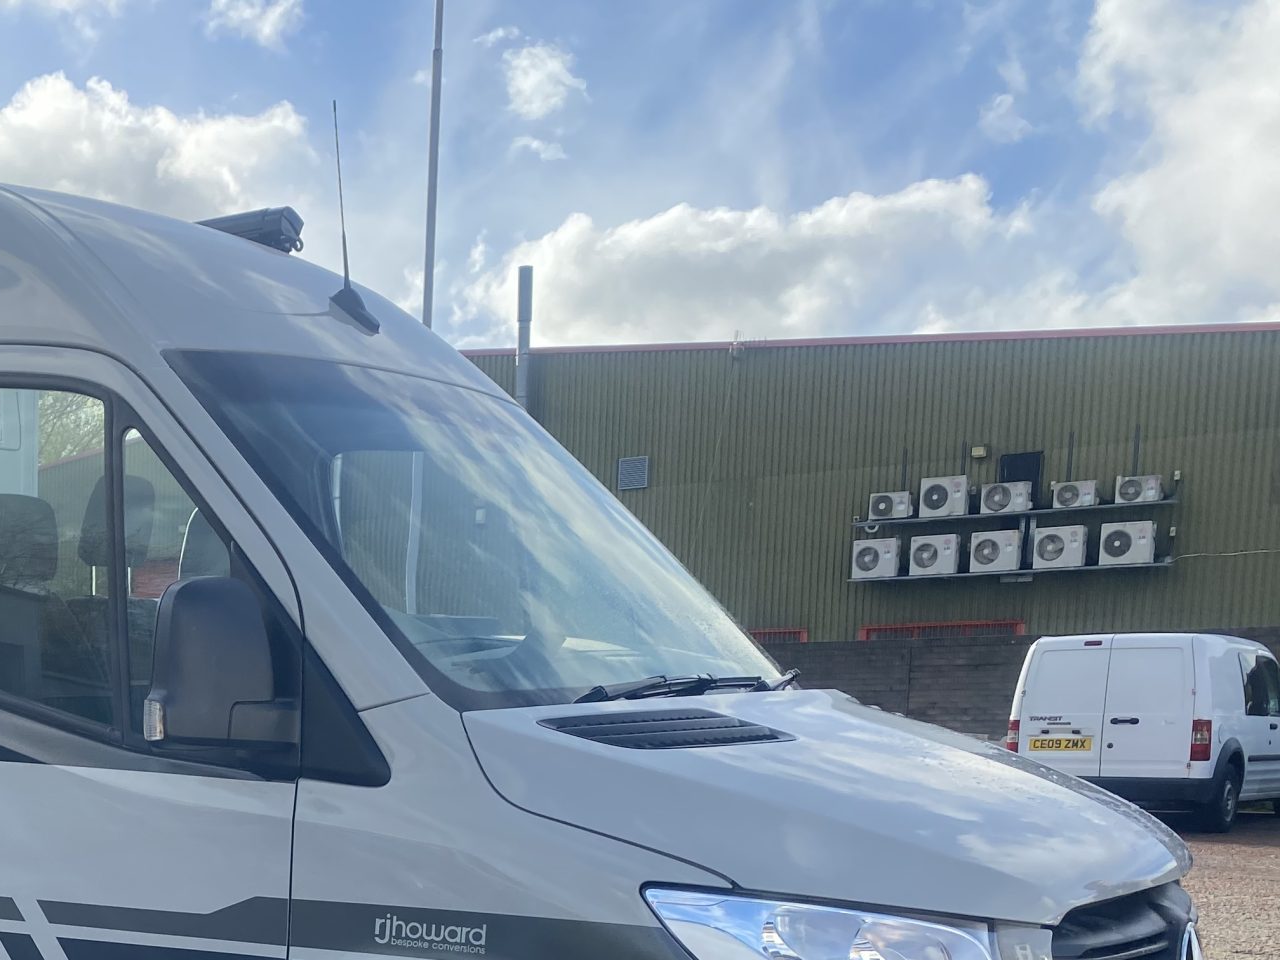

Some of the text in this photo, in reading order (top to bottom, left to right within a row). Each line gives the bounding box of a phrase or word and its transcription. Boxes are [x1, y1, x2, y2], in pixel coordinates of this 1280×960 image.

[1033, 739, 1062, 749] CE09
[374, 913, 487, 946] rjhoward
[391, 937, 486, 955] bespoke conversions
